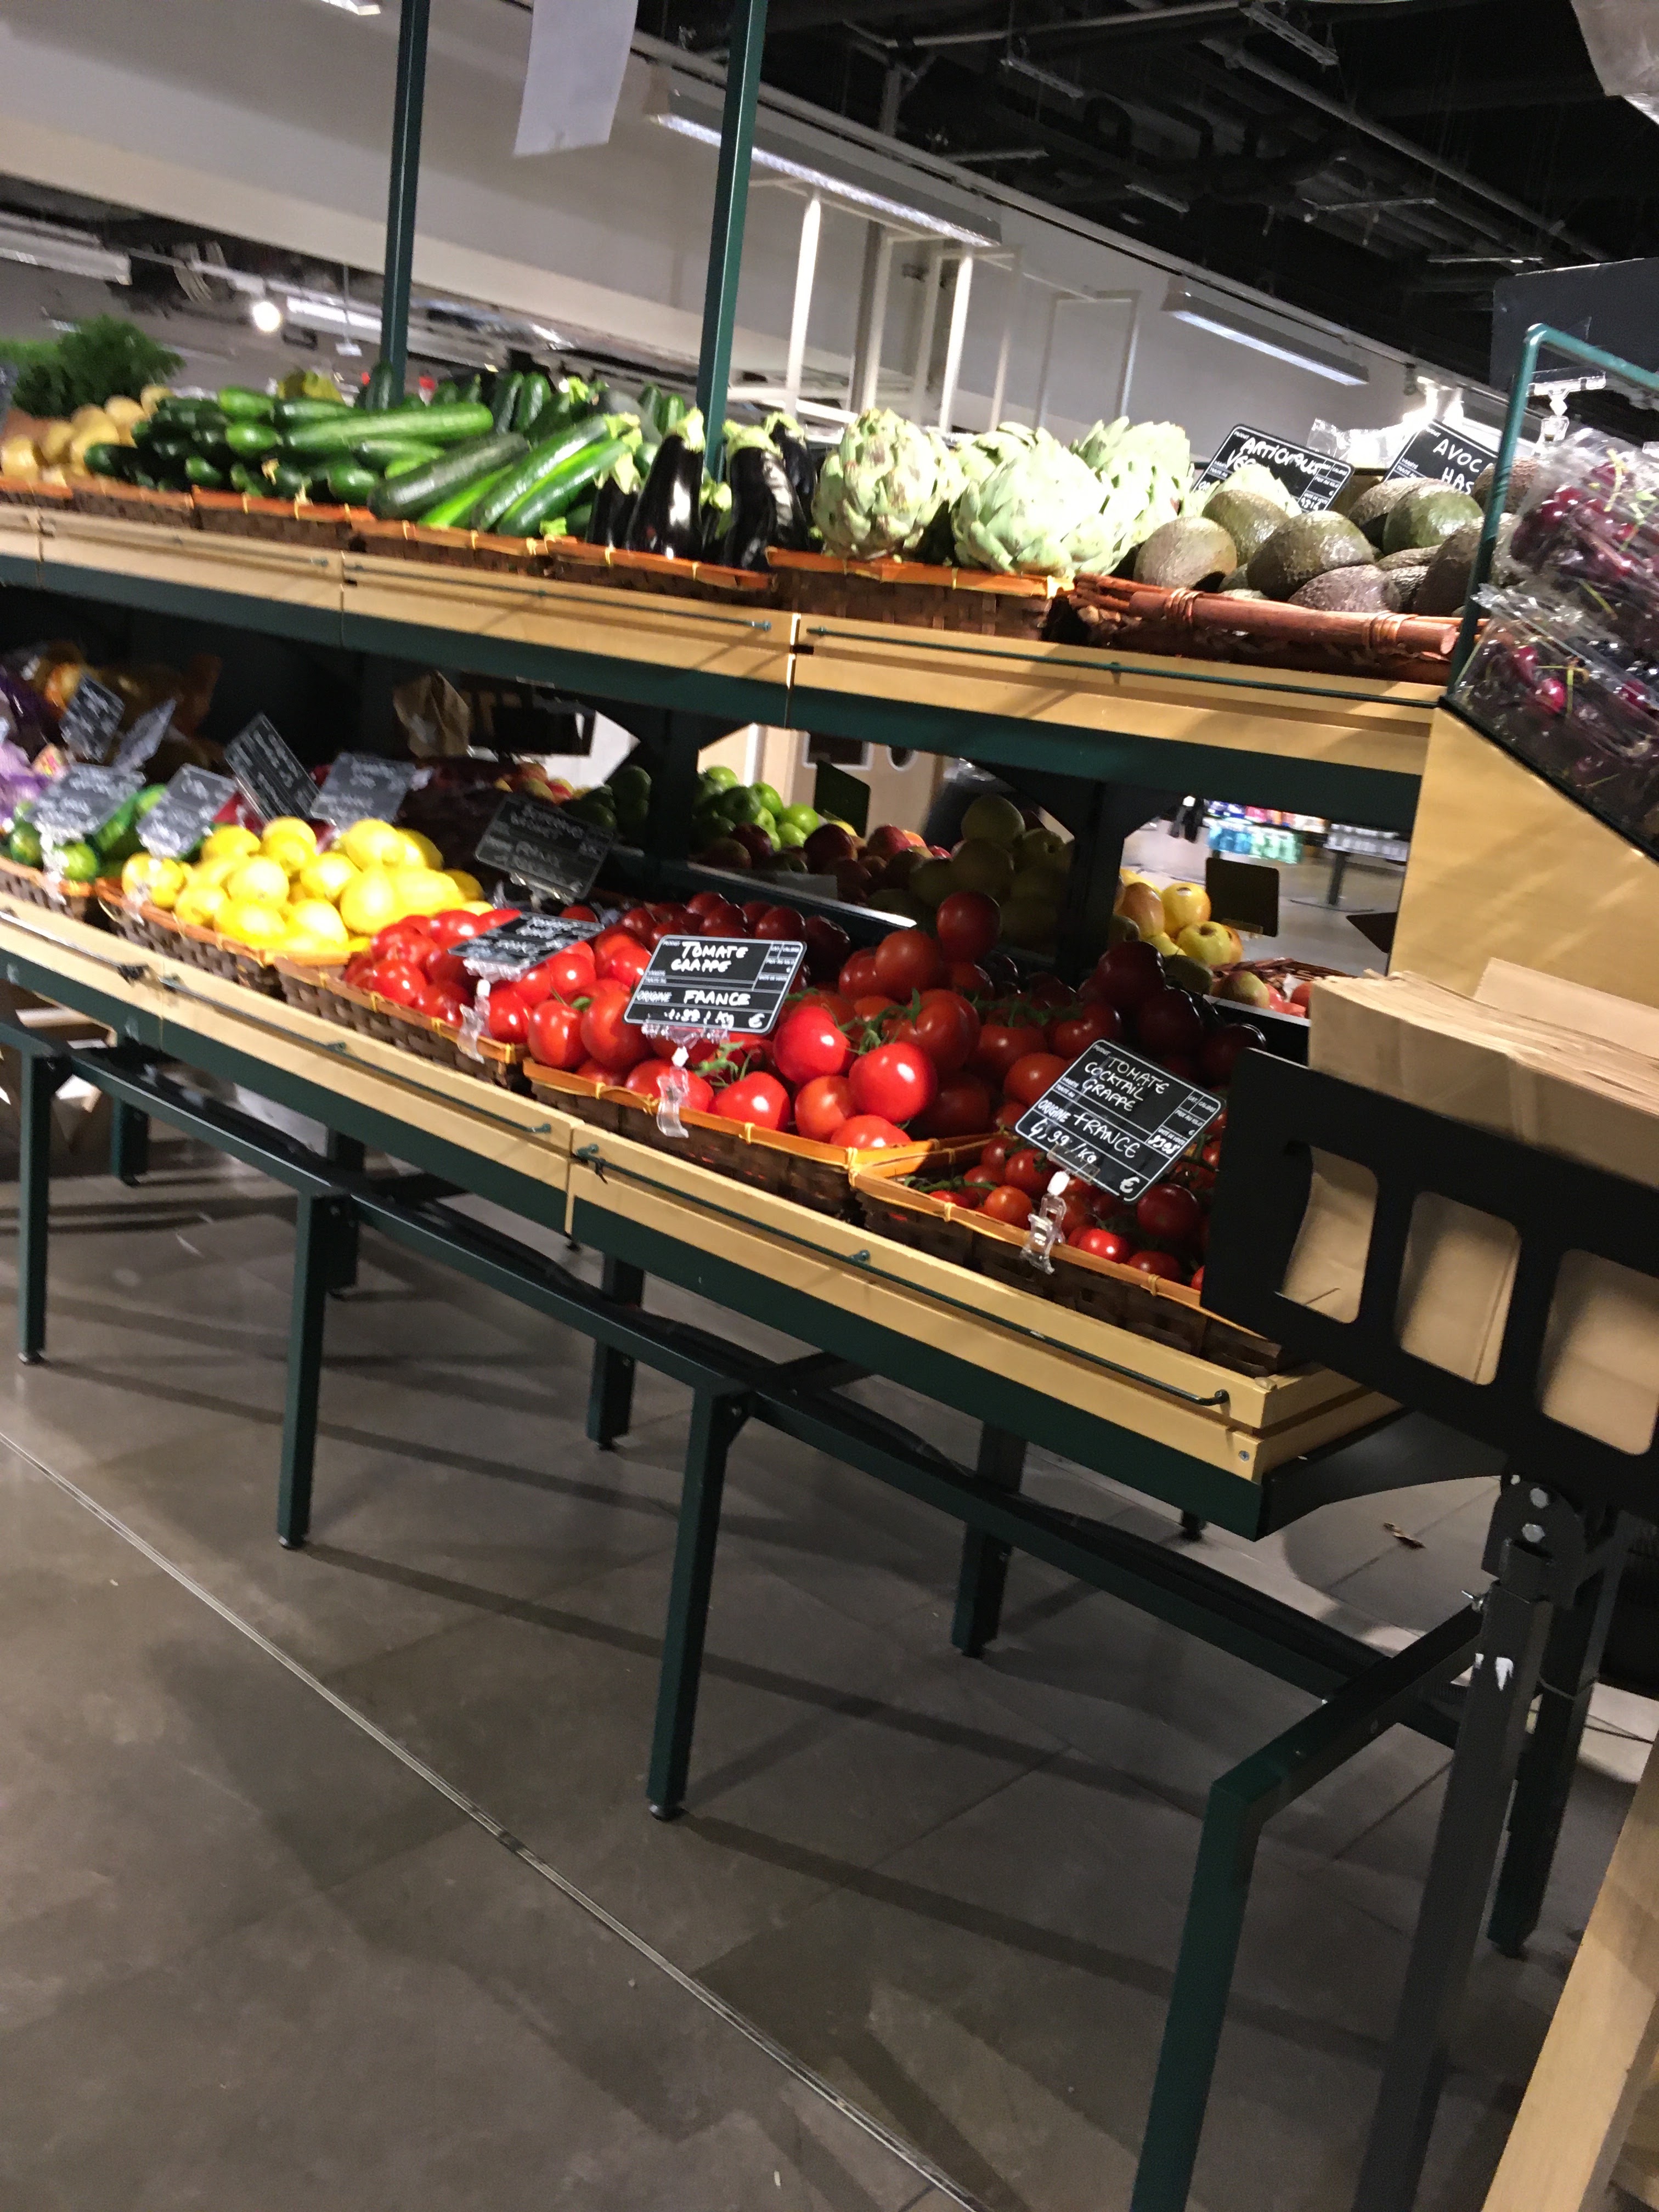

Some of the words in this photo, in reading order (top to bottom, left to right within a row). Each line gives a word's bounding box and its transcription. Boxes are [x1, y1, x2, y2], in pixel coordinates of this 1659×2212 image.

[1432, 438, 1494, 473] AVOC
[682, 941, 748, 959] TOMATE
[671, 958, 732, 973] GRAPPE
[684, 990, 751, 1006] FRANCE
[748, 1013, 765, 1029] €
[1108, 1056, 1170, 1094] TOMATE
[1082, 1079, 1136, 1111] GRAPPE
[1038, 1099, 1071, 1122] ORIGINE
[1074, 1112, 1140, 1158] FRANCE
[1119, 1176, 1140, 1193] €
